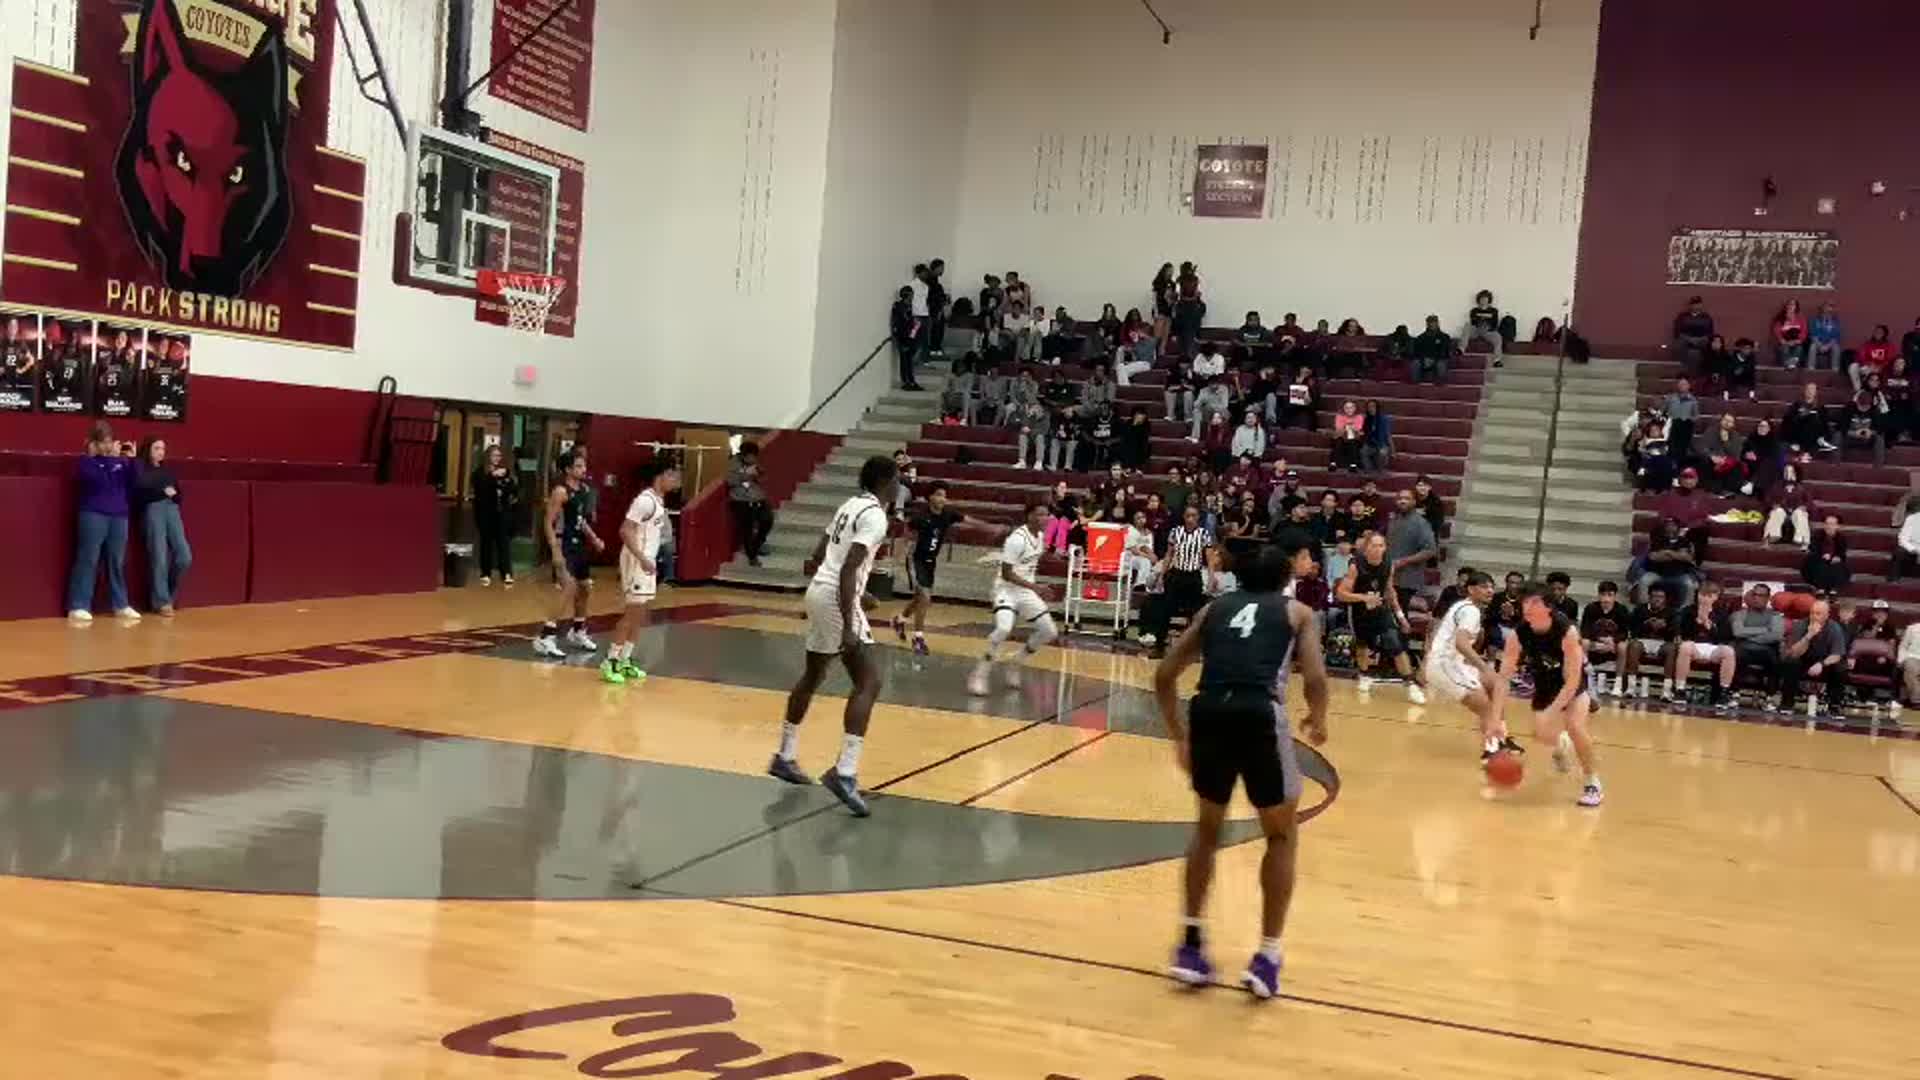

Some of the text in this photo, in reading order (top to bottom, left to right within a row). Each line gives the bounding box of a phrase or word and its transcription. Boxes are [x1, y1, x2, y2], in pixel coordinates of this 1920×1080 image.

[186, 5, 251, 49] COYOTES
[106, 279, 281, 333] PACK STRONG
[929, 537, 939, 551] 5
[1228, 603, 1259, 638] 4
